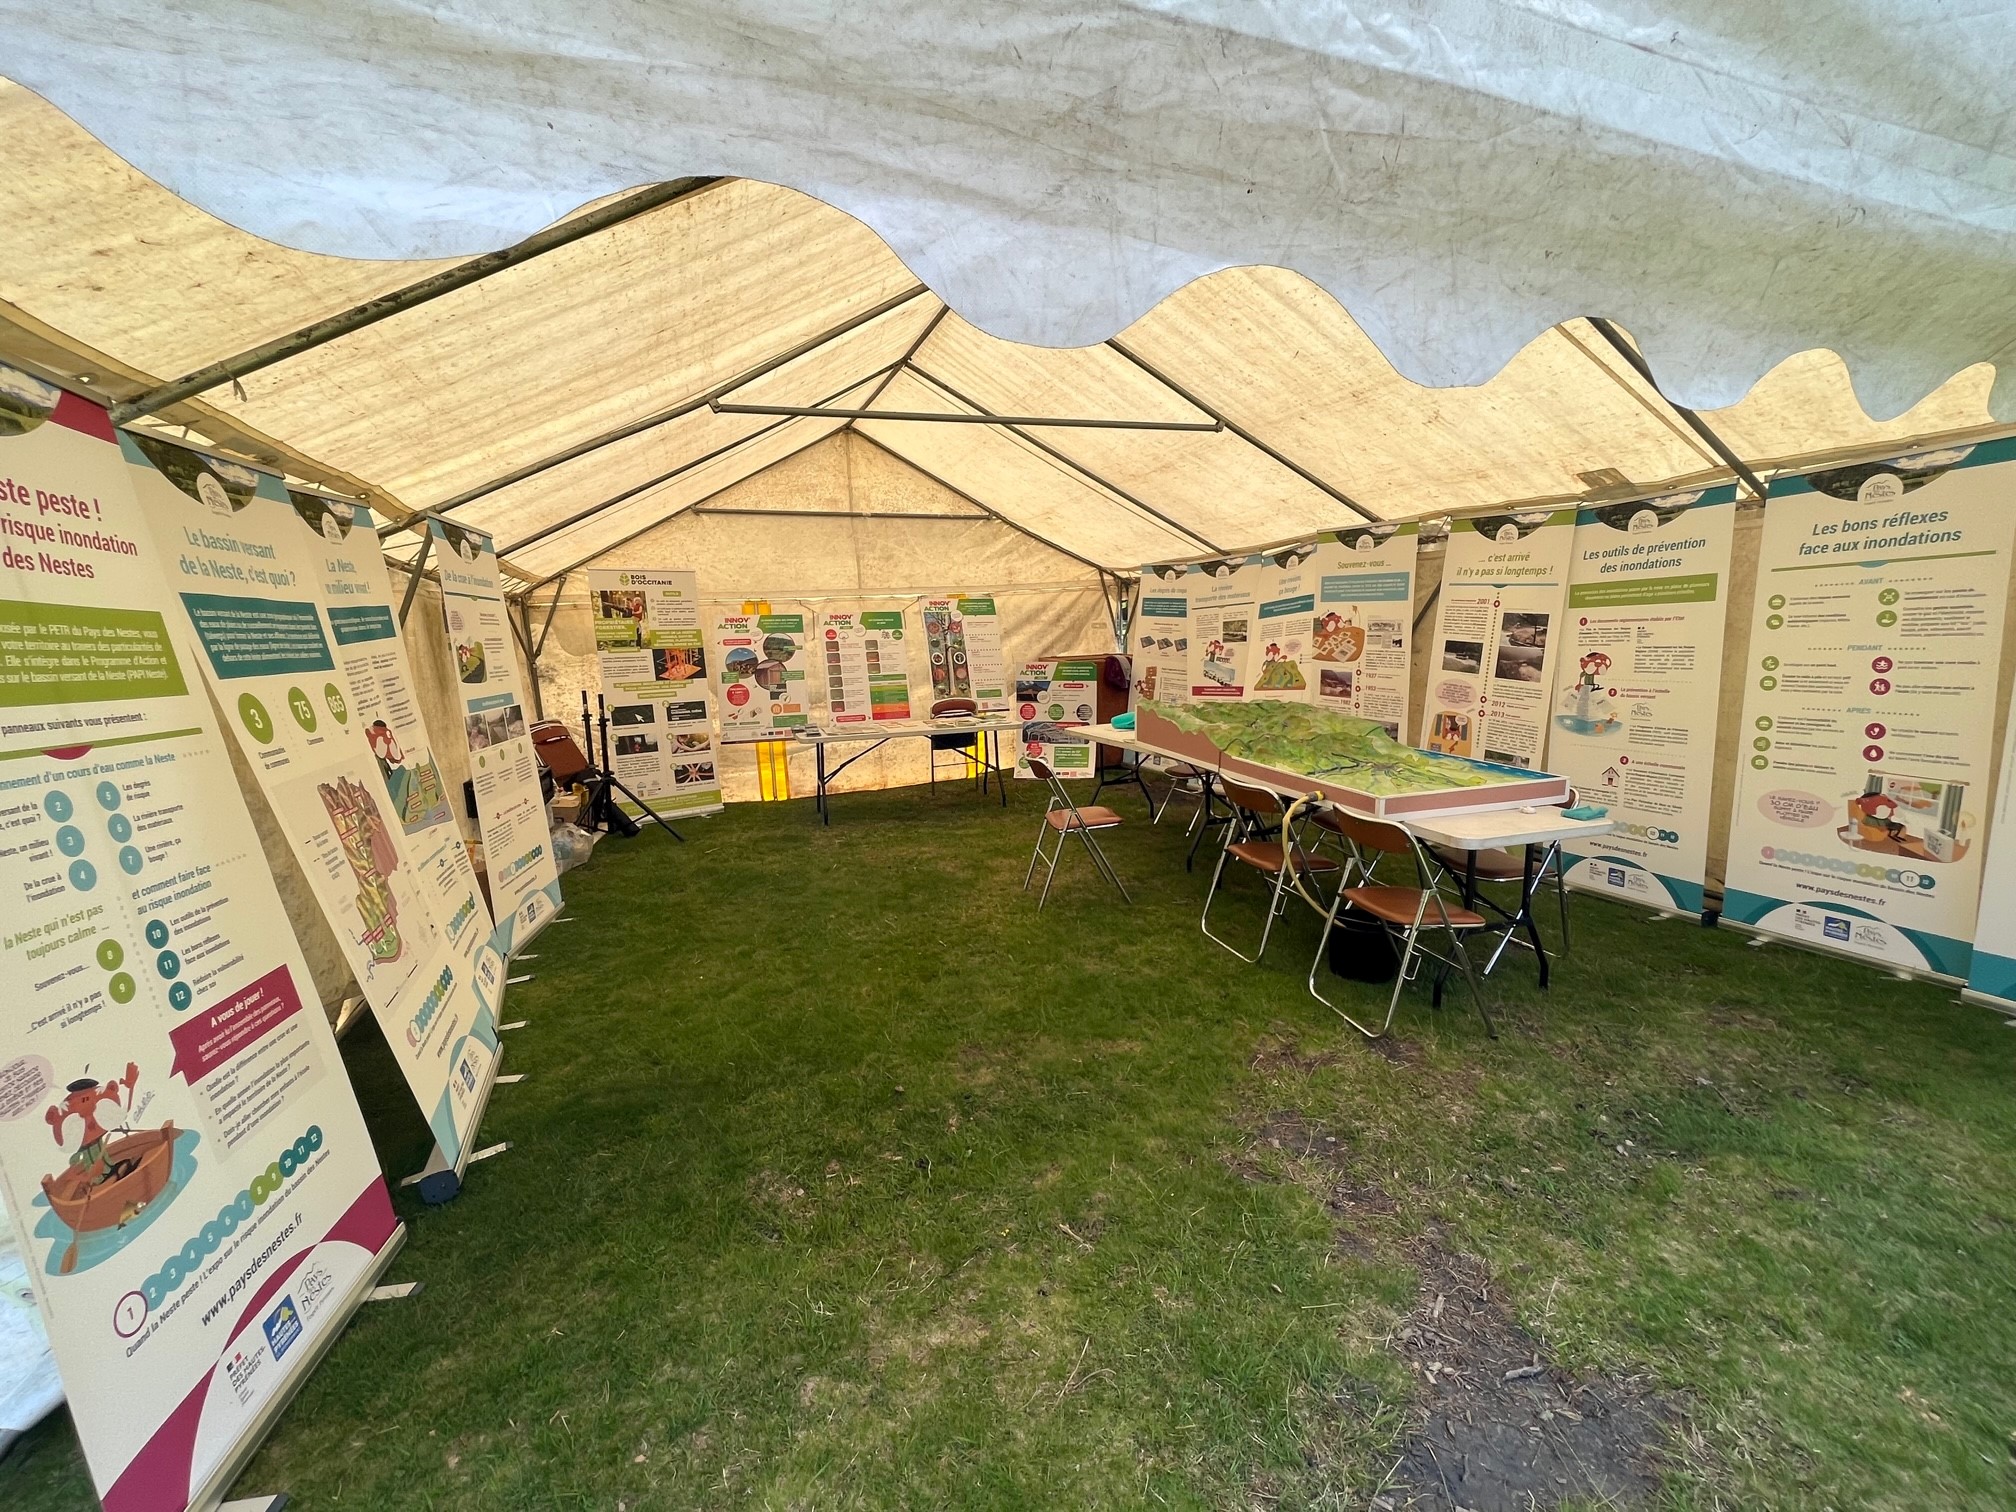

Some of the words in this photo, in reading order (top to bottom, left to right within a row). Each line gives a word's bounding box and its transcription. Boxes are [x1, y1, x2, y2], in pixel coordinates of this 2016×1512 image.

[36, 489, 90, 519] peste
[93, 498, 102, 521] !
[1812, 523, 1838, 536] Les
[1842, 519, 1878, 533] bons
[1882, 511, 1948, 528] réflexes
[0, 513, 56, 544] risque
[57, 522, 138, 556] inondation
[183, 525, 200, 547] Le
[199, 528, 240, 554] bassin
[1583, 550, 1600, 561] Les
[1602, 546, 1629, 559] outils
[1632, 543, 1645, 555] de
[1646, 537, 1706, 556] prévention
[1799, 541, 1829, 556] face
[1833, 541, 1860, 553] aux
[1864, 530, 1962, 550] inondations
[2, 546, 35, 571] des
[38, 552, 94, 578] Nestes
[1487, 553, 1506, 563] c'est
[1507, 551, 1531, 563] arrivé
[180, 554, 198, 575] de
[196, 556, 210, 577] la
[209, 560, 248, 584] Neste,
[248, 566, 269, 585] c'est
[269, 570, 290, 589] quoi
[290, 571, 296, 586] ?
[1456, 566, 1462, 576] il
[1463, 566, 1474, 578] n'y
[1475, 568, 1481, 576] a
[1481, 568, 1495, 579] pas
[1495, 566, 1504, 576] si
[1504, 565, 1547, 578] longtemps
[1600, 563, 1617, 574] des
[1620, 556, 1682, 573] inondations
[83, 626, 101, 639] Pays
[103, 627, 115, 637] des
[5, 655, 22, 667] Elle
[31, 672, 58, 683] bassin
[60, 672, 88, 682] versant
[294, 700, 311, 720] 75
[250, 709, 263, 729] 3
[1, 723, 46, 737] panneaux
[47, 719, 83, 731] suivants
[85, 717, 103, 727] vous
[44, 770, 65, 784] d'un
[66, 767, 91, 780] cours
[92, 763, 114, 775] d'eau
[116, 759, 144, 771] comme
[145, 755, 153, 766] la
[153, 753, 175, 764] Neste
[106, 791, 111, 800] 5
[55, 802, 62, 812] 2
[117, 823, 123, 833] 6
[66, 836, 74, 846] 3
[128, 856, 133, 865] 7
[80, 870, 86, 880] 4
[1906, 875, 1913, 883] 11
[132, 888, 139, 900] et
[141, 875, 178, 897] comment
[178, 870, 195, 884] faire
[195, 865, 211, 877] face
[137, 906, 148, 915] au
[148, 895, 173, 911] risque
[173, 880, 212, 900] inondation
[1796, 881, 1887, 906] www.paysdesnestes.fr
[3, 937, 14, 950] la
[14, 927, 42, 946] Neste
[43, 917, 59, 936] qui
[61, 910, 85, 927] n'est
[87, 904, 104, 922] pas
[152, 929, 161, 939] 10
[26, 937, 66, 961] toujours
[68, 924, 97, 944] calme
[107, 950, 113, 960] 8
[164, 960, 173, 970] 11
[119, 984, 125, 993] 9
[175, 990, 185, 1001] 12
[211, 1016, 217, 1028] A
[217, 1008, 235, 1023] vous
[235, 1001, 244, 1013] de
[243, 991, 260, 1010] jouer
[284, 1158, 292, 1169] 10
[225, 1216, 231, 1226] 6
[207, 1232, 213, 1242] 5
[190, 1249, 195, 1260] 4
[170, 1268, 176, 1279] 3
[201, 1211, 303, 1327] www.paysdesnestes.fr
[126, 1327, 151, 1358] Quand
[151, 1321, 159, 1332] la
[159, 1300, 180, 1324] Neste
[180, 1280, 199, 1304] peste
[203, 1257, 224, 1280] L'expo
[223, 1246, 234, 1260] sur
[234, 1239, 240, 1250] le
[149, 1287, 157, 1298] 2
[127, 1306, 133, 1320] 1
